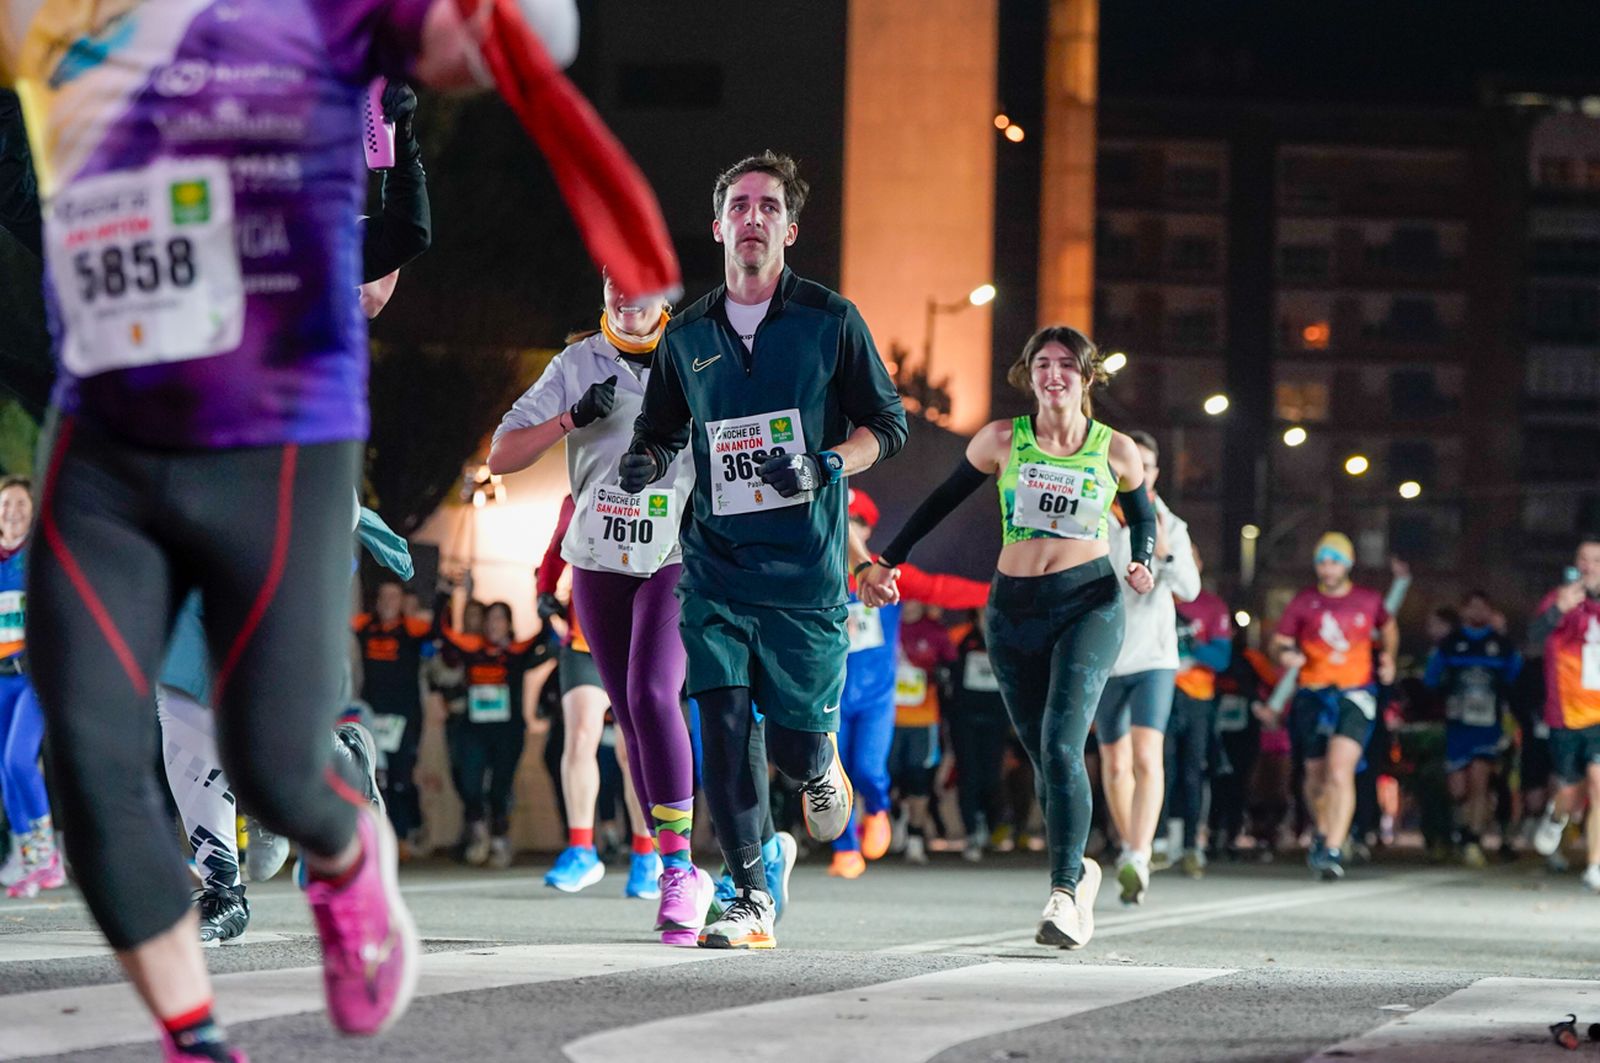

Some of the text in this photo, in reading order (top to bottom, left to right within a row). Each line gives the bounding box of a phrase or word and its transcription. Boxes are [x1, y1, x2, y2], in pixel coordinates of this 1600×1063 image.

[73, 236, 196, 304] 5858
[723, 427, 747, 440] NOCHE
[749, 426, 761, 437] DE
[715, 437, 763, 453] SAN ANTÓN
[1027, 480, 1044, 489] SAN
[1038, 472, 1063, 483] NOCHE
[1065, 477, 1075, 486] DE
[596, 503, 612, 513] SAN
[607, 495, 628, 506] NOCHE
[630, 498, 640, 507] DE
[1039, 492, 1079, 516] 601
[603, 515, 653, 544] 7610
